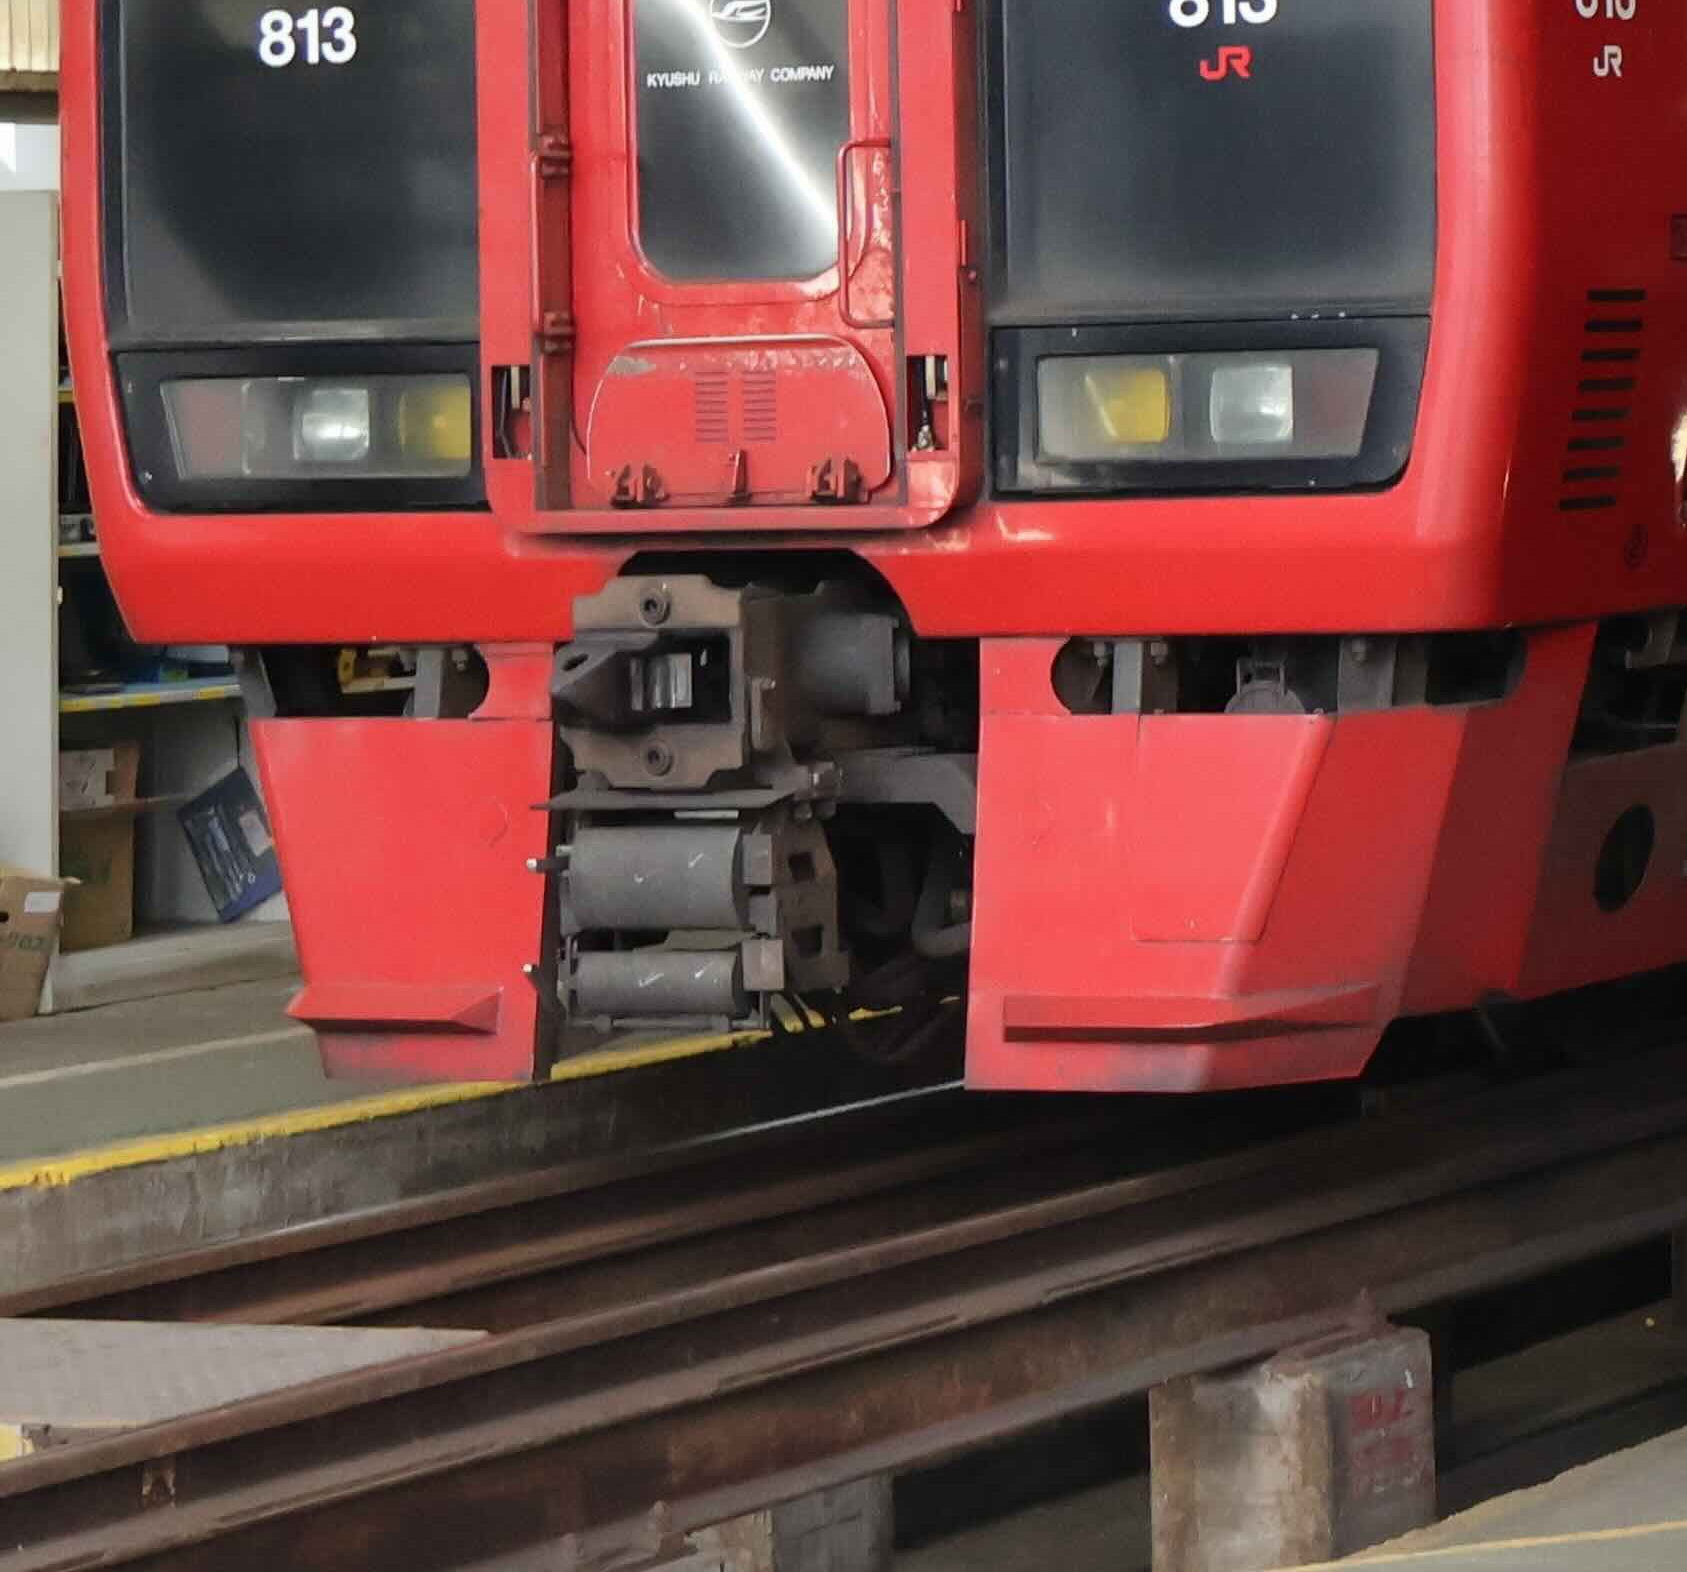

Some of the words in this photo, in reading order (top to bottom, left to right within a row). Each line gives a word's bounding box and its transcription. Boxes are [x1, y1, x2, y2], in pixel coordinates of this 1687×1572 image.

[258, 6, 358, 67] 813
[646, 71, 701, 88] KYUSHU
[769, 64, 835, 82] COMPANY
[1199, 45, 1254, 80] JR
[1592, 44, 1624, 78] JR
